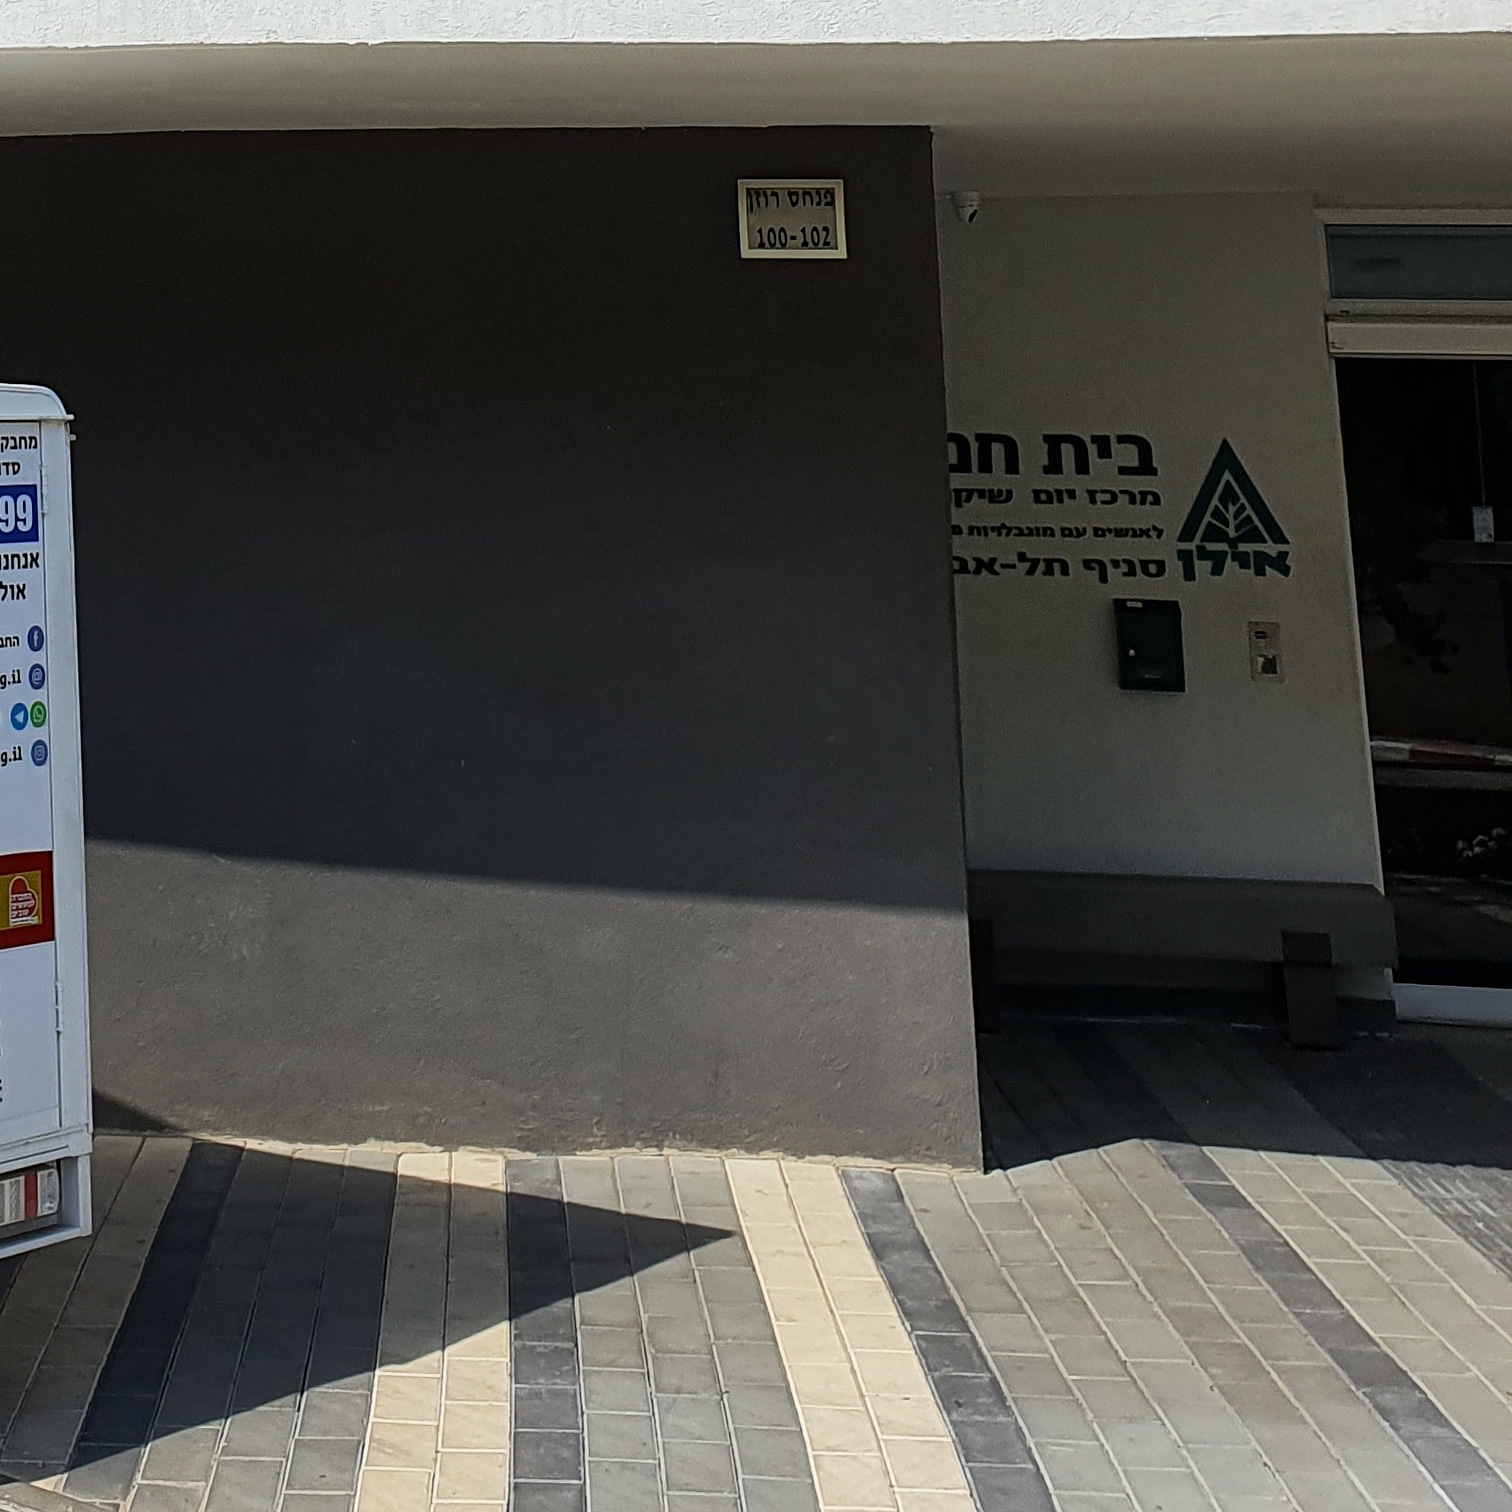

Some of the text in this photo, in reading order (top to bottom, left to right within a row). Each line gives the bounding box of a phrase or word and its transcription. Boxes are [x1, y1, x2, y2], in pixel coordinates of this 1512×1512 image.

[748, 191, 834, 213] פנחס רוזן
[757, 226, 831, 248] 100-102
[947, 433, 1158, 476] בית חנ
[953, 488, 1161, 508] מרכז יום שיק
[1060, 526, 1087, 538] עם
[1093, 526, 1164, 539] לאנשים
[953, 552, 1166, 584] סניף תל-אב
[1177, 545, 1291, 581] אילן
